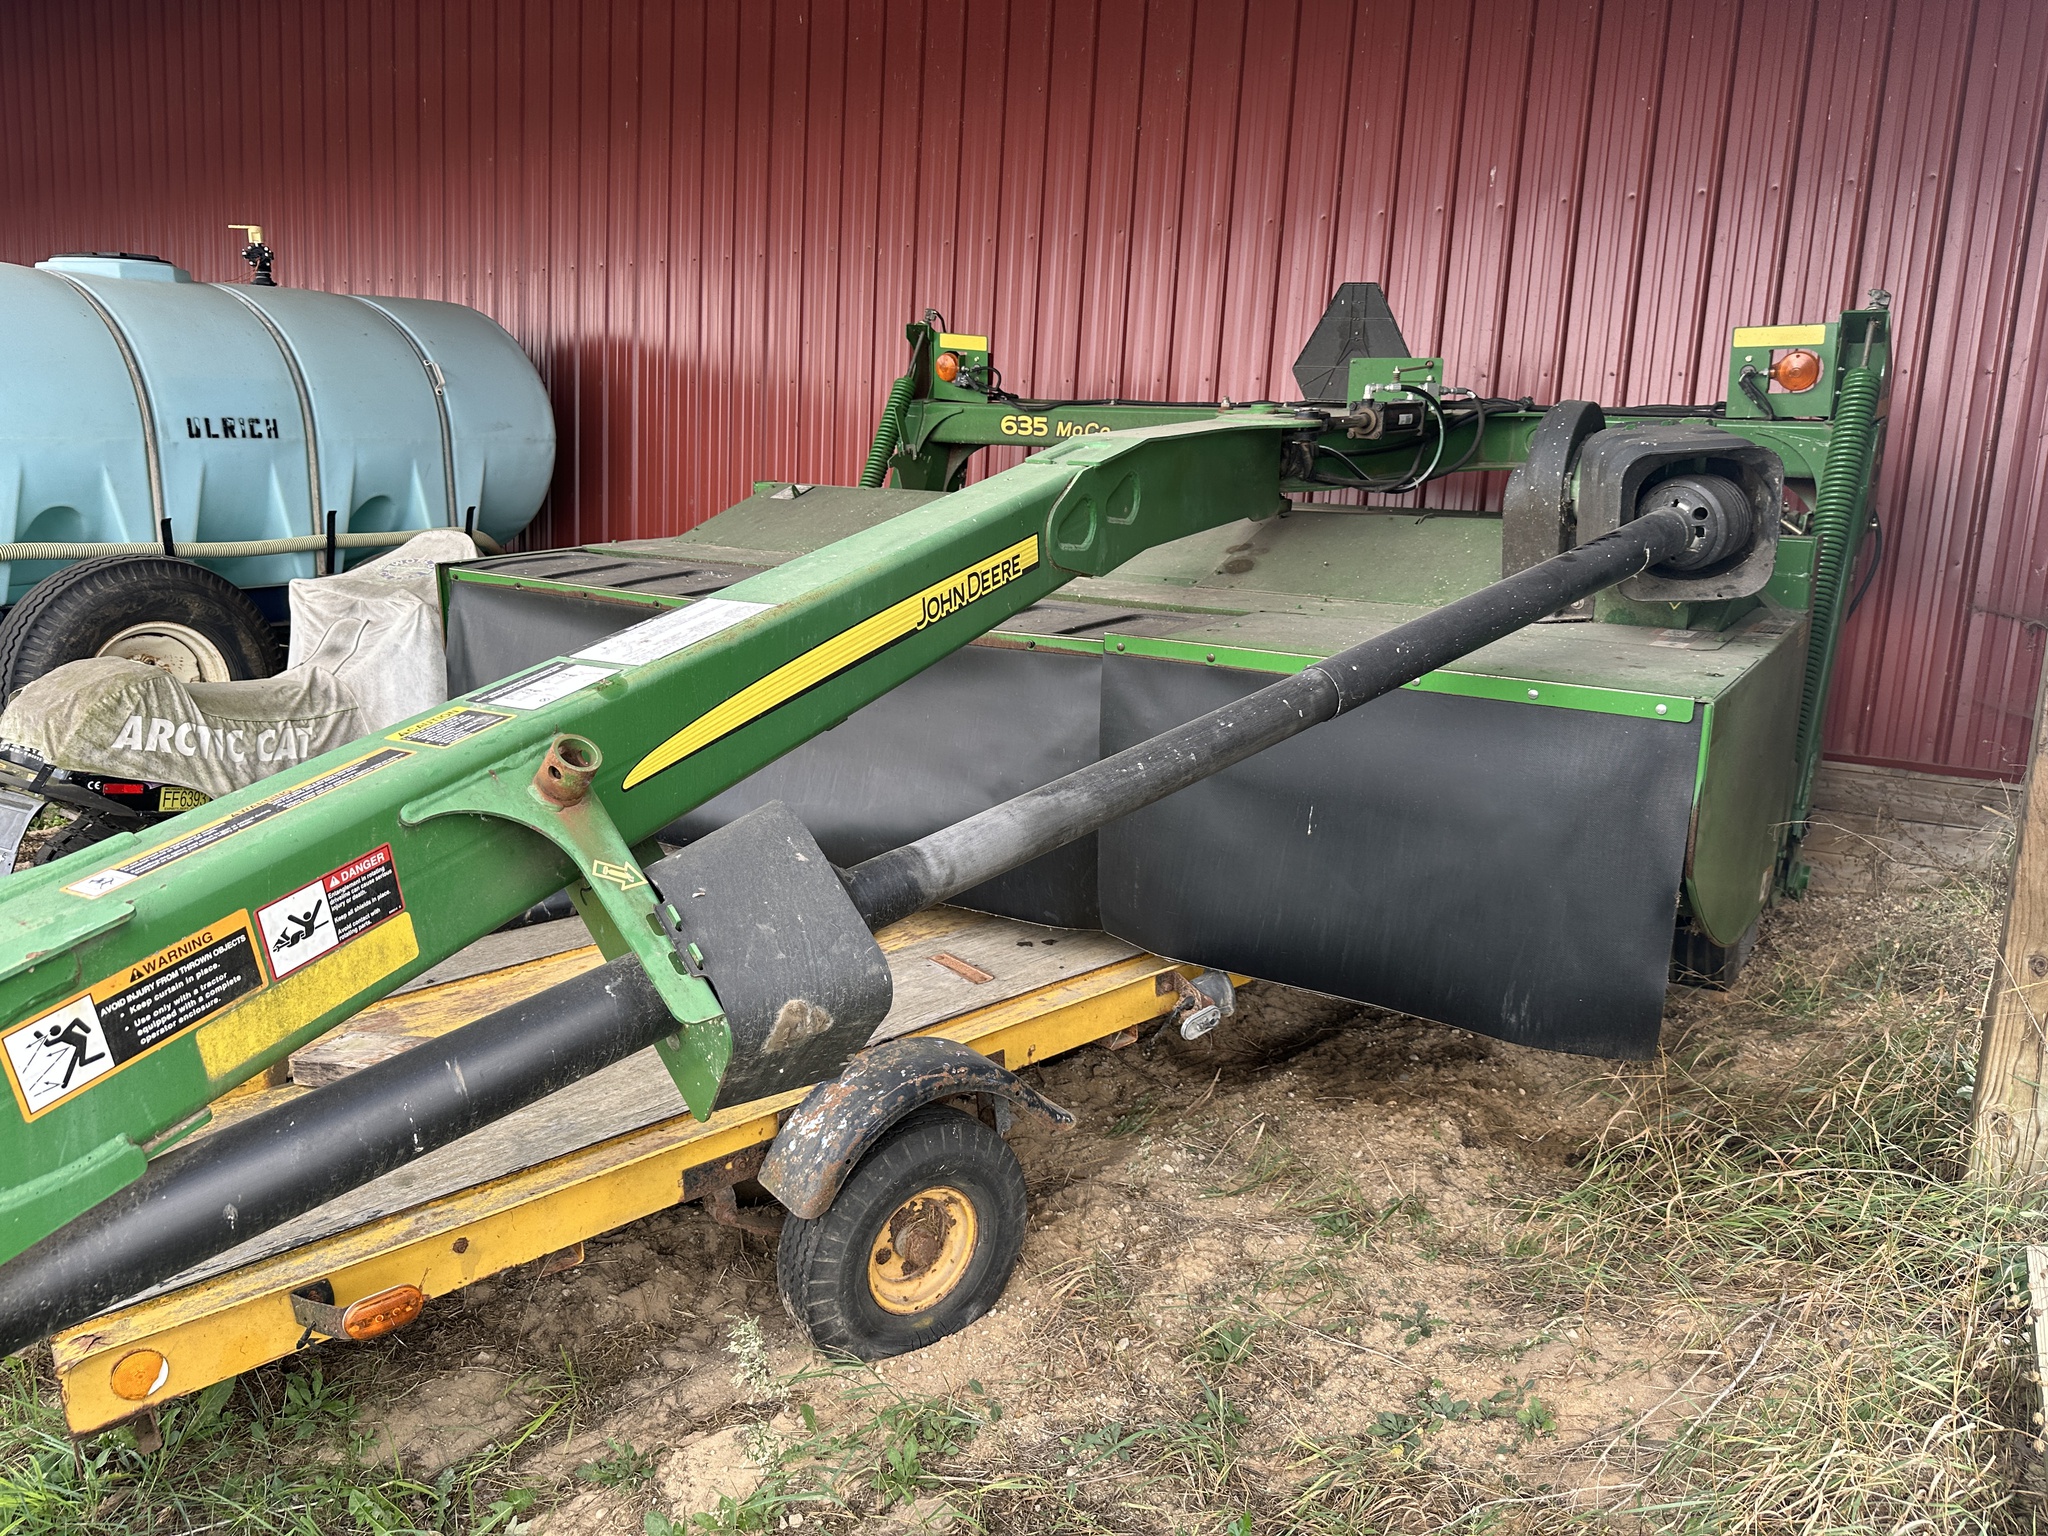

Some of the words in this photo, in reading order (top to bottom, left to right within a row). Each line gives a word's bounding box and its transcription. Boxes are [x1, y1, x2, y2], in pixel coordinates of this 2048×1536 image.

[186, 417, 279, 438] ULRICH
[1000, 415, 1049, 437] 635
[917, 583, 965, 627] JOHN
[967, 554, 1021, 600] DEERE
[110, 716, 245, 763] ARCTIC
[256, 727, 313, 762] CAT
[162, 790, 207, 808] FF6393
[340, 852, 385, 882] DANGER
[375, 869, 393, 881] serious
[334, 913, 348, 924] Keep
[338, 923, 352, 936] Avoid
[352, 913, 370, 927] contact
[370, 907, 381, 917] with
[142, 931, 213, 974] WARNING
[101, 998, 126, 1018] AVOID
[126, 982, 155, 1003] INJURY
[155, 969, 179, 987] FROM
[179, 952, 213, 975] THROWN
[213, 934, 246, 957] OBJECTS
[129, 998, 153, 1014] Keep
[154, 981, 185, 1001] curtain
[185, 975, 195, 984] in
[195, 963, 221, 980] place.
[133, 1014, 151, 1027] Use
[153, 1003, 172, 1018] only
[173, 992, 192, 1006] with
[200, 972, 227, 991] tractor
[137, 1009, 177, 1036] equipped
[178, 999, 197, 1013] with
[198, 995, 204, 1003] a
[205, 975, 241, 998] complete
[140, 1020, 177, 1045] operator
[178, 998, 221, 1023] enclosure.
